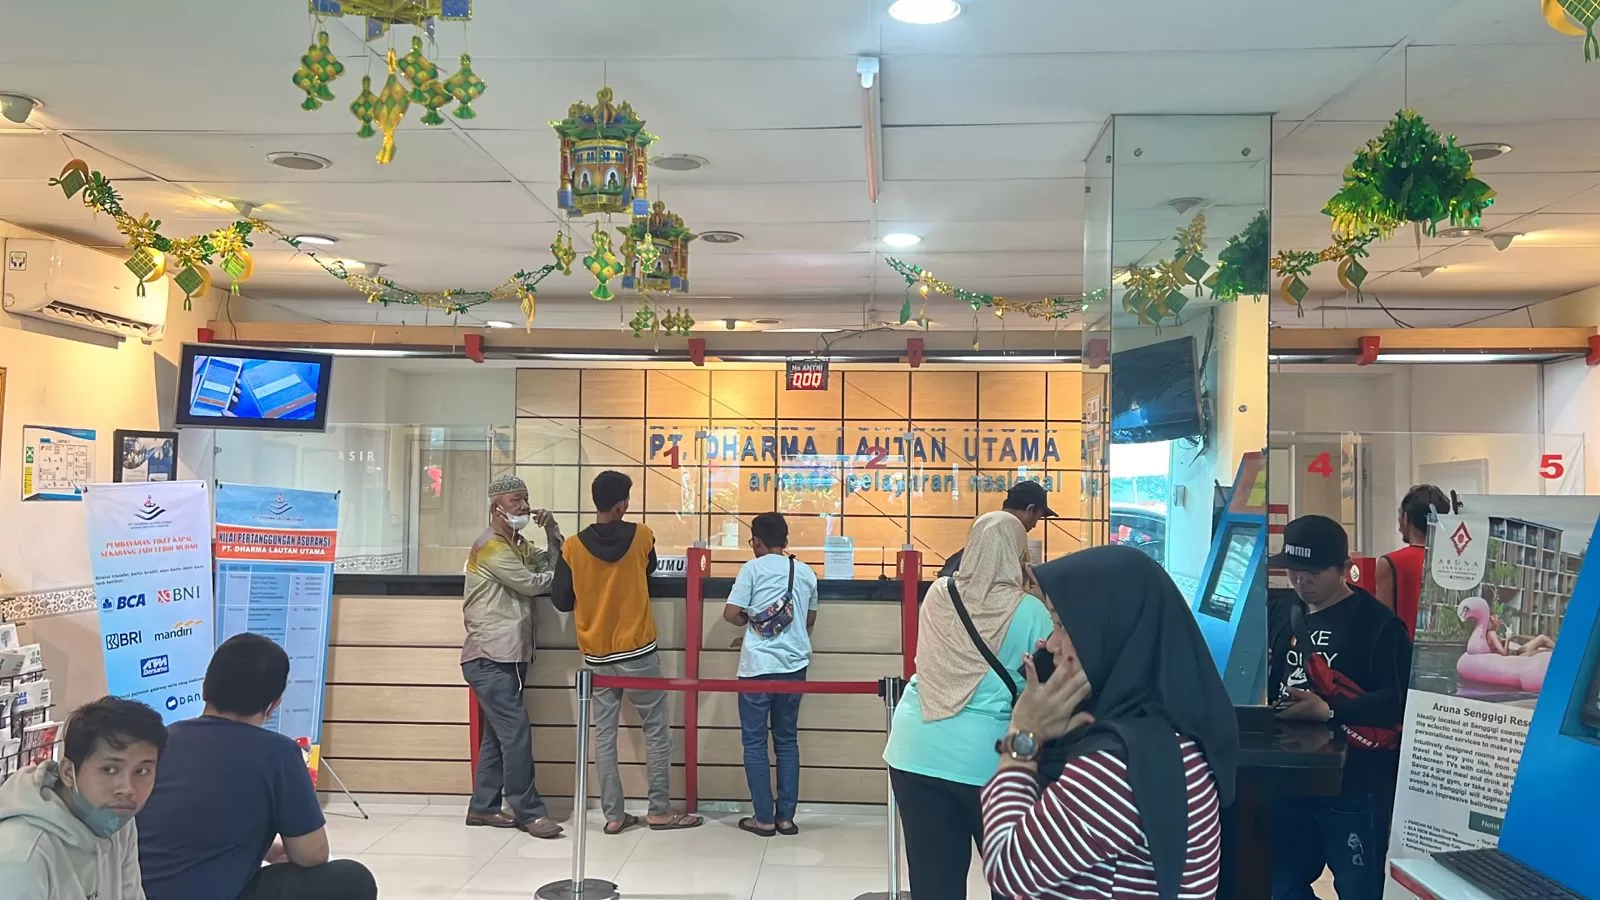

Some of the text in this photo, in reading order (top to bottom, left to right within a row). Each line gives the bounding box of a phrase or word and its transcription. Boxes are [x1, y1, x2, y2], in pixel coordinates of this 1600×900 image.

[802, 363, 823, 372] ANTRI
[663, 446, 680, 469] 1
[705, 433, 819, 463] DHARMA
[836, 434, 946, 463] LAUTAN
[964, 436, 1061, 463] UTAMA
[864, 446, 888, 470] 2
[1307, 452, 1334, 478] 4
[1538, 454, 1564, 479] 5
[106, 540, 151, 549] PEMBAYARAN
[219, 532, 331, 547] NILAI PERTANGGUNGAN ASURANSI
[100, 549, 137, 558] SEKARANG
[176, 543, 198, 551] MUDAH
[1285, 543, 1311, 558] PUMA
[1438, 559, 1478, 567] ARUNA
[117, 593, 146, 610] BCA
[173, 586, 200, 601] BNI
[120, 630, 142, 647] BRI
[154, 627, 193, 641] mandiri
[143, 656, 167, 670] ATM
[1416, 712, 1436, 722] Ideally
[1437, 716, 1461, 726] located
[1470, 722, 1499, 734] Senggigi
[1432, 702, 1461, 715] Aruna
[1463, 708, 1507, 725] Senggigi
[1415, 720, 1426, 728] the
[1427, 723, 1451, 732] eclectic
[1473, 731, 1499, 741] modern
[1500, 736, 1512, 744] and
[1413, 737, 1443, 750] Intuitively
[1444, 744, 1473, 755] designed
[1474, 751, 1496, 760] rooms
[1454, 736, 1481, 747] services
[1490, 743, 1508, 752] make
[1411, 753, 1444, 765] flat-screen
[1446, 760, 1458, 769] TVs
[1475, 768, 1493, 776] cable
[1413, 745, 1430, 754] travel
[1446, 754, 1459, 762] way
[1462, 756, 1474, 764] you
[1494, 762, 1510, 771] from
[1411, 761, 1430, 770] Savor
[1435, 767, 1452, 775] great
[1453, 771, 1469, 779] meal
[1469, 775, 1483, 783] and
[1483, 778, 1501, 786] drink
[1422, 771, 1446, 782] 24-hour
[1472, 783, 1486, 791] take
[1492, 788, 1504, 796] dip
[1409, 777, 1429, 787] events
[1439, 783, 1468, 797] Senggigi
[1435, 790, 1469, 804] impressive
[1470, 799, 1499, 811] ballroom
